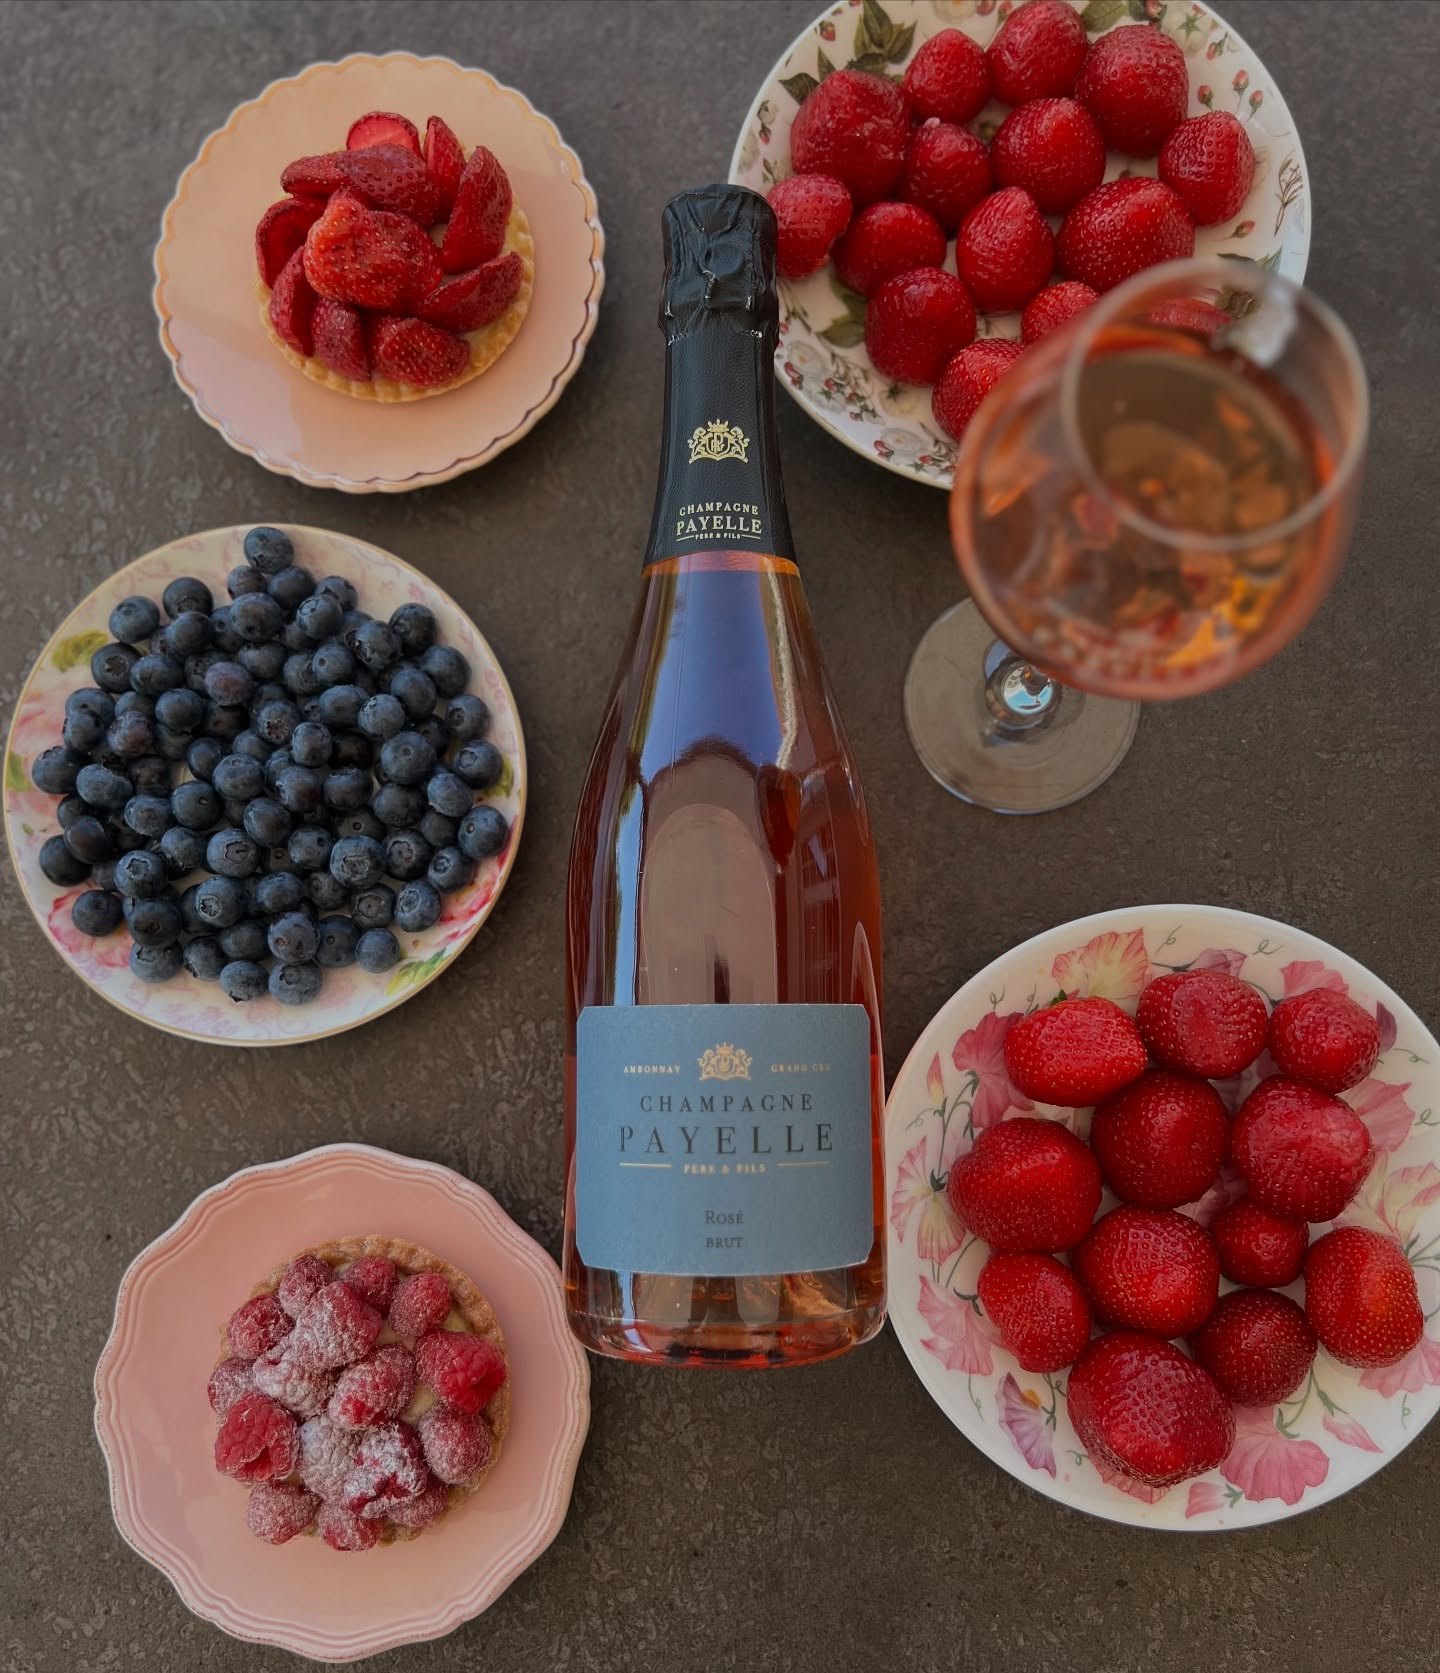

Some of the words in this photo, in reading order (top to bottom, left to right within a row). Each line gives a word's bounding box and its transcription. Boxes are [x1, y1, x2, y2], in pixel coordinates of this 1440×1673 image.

[679, 502, 759, 516] CHAMPAGNE
[676, 516, 762, 535] PAYELLE
[771, 1063, 808, 1073] GRAND
[640, 1093, 813, 1113] CHAMPAGNE
[619, 1123, 833, 1154] PAYELLE
[737, 1163, 766, 1174] FILS
[705, 1236, 744, 1249] BRUT
